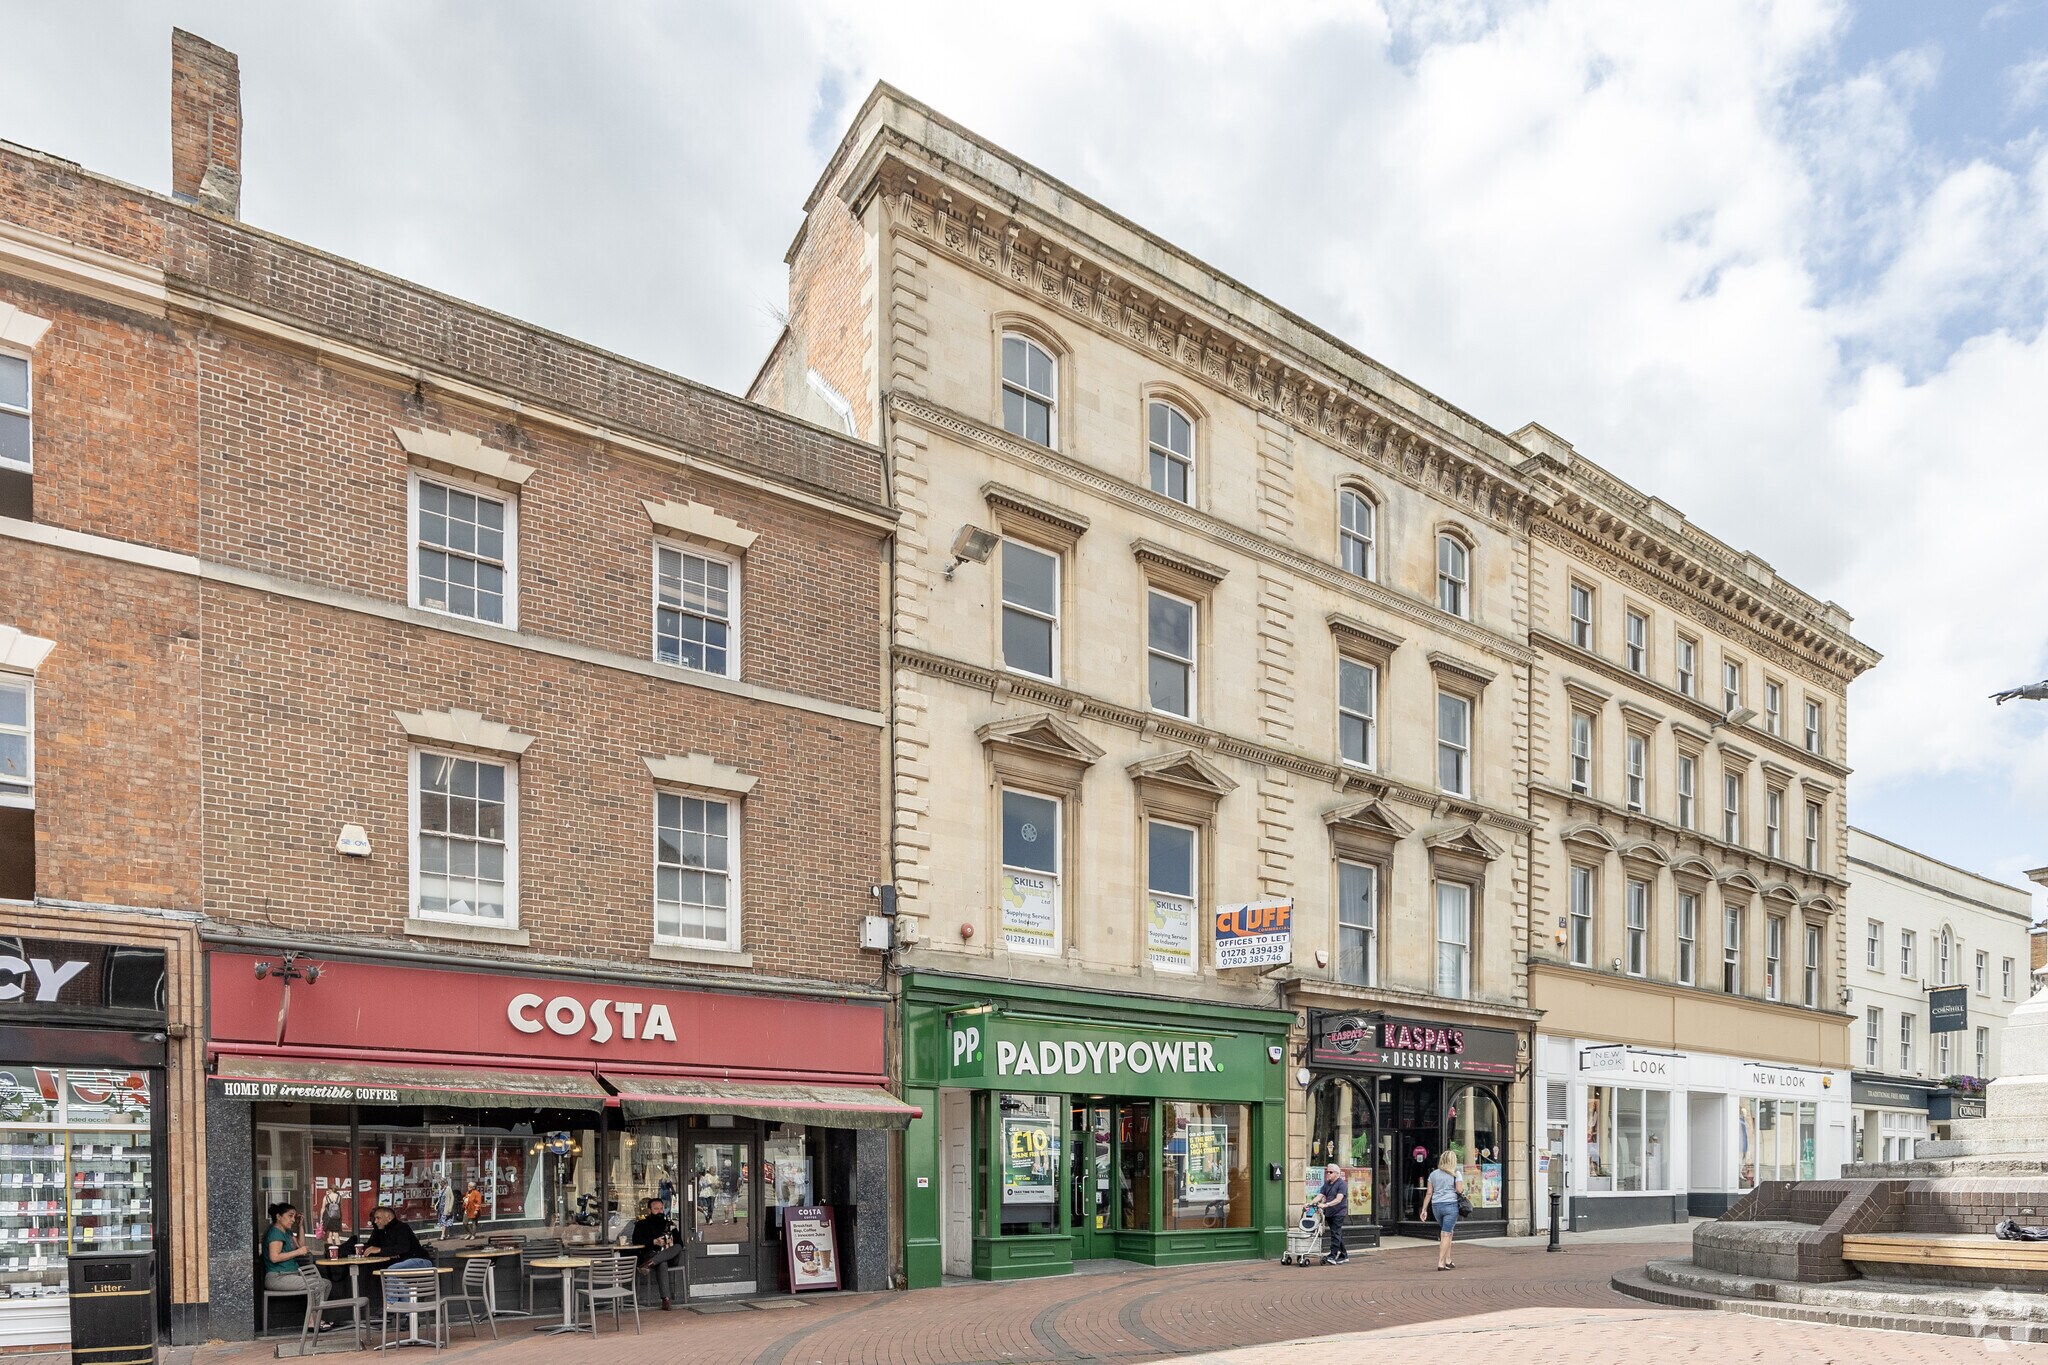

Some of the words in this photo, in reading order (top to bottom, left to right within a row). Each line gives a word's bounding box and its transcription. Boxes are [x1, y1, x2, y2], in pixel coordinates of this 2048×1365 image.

[1014, 877, 1044, 888] SKILLS
[1019, 888, 1051, 898] DIRECT
[1157, 901, 1182, 911] SKILLS
[1217, 906, 1290, 935] CLUFF
[1006, 935, 1025, 943] 01278
[1027, 938, 1048, 946] 421111
[1219, 938, 1252, 947] OFFICES
[1221, 949, 1246, 957] 01278
[1250, 945, 1283, 955] 439439
[1223, 957, 1247, 965] 07802
[1932, 1005, 1964, 1014] CORNHILL
[508, 993, 677, 1043] COSTA
[1331, 1029, 1362, 1042] KASPA'S
[1384, 1023, 1464, 1053] KASPA'S
[1394, 1052, 1449, 1070] DESSERTS
[1593, 1059, 1621, 1067] LOOK
[1633, 1060, 1665, 1074] LOOK
[1754, 1073, 1775, 1084] NEW
[1780, 1076, 1805, 1087] LOOK
[224, 1082, 259, 1095] HOME
[262, 1083, 277, 1096] OF
[279, 1085, 353, 1099] irresistible
[356, 1088, 397, 1100] COFFEE
[1868, 1090, 1891, 1098] TRADITIONAL
[1012, 1129, 1047, 1152] £10
[94, 1284, 122, 1292] Litter
